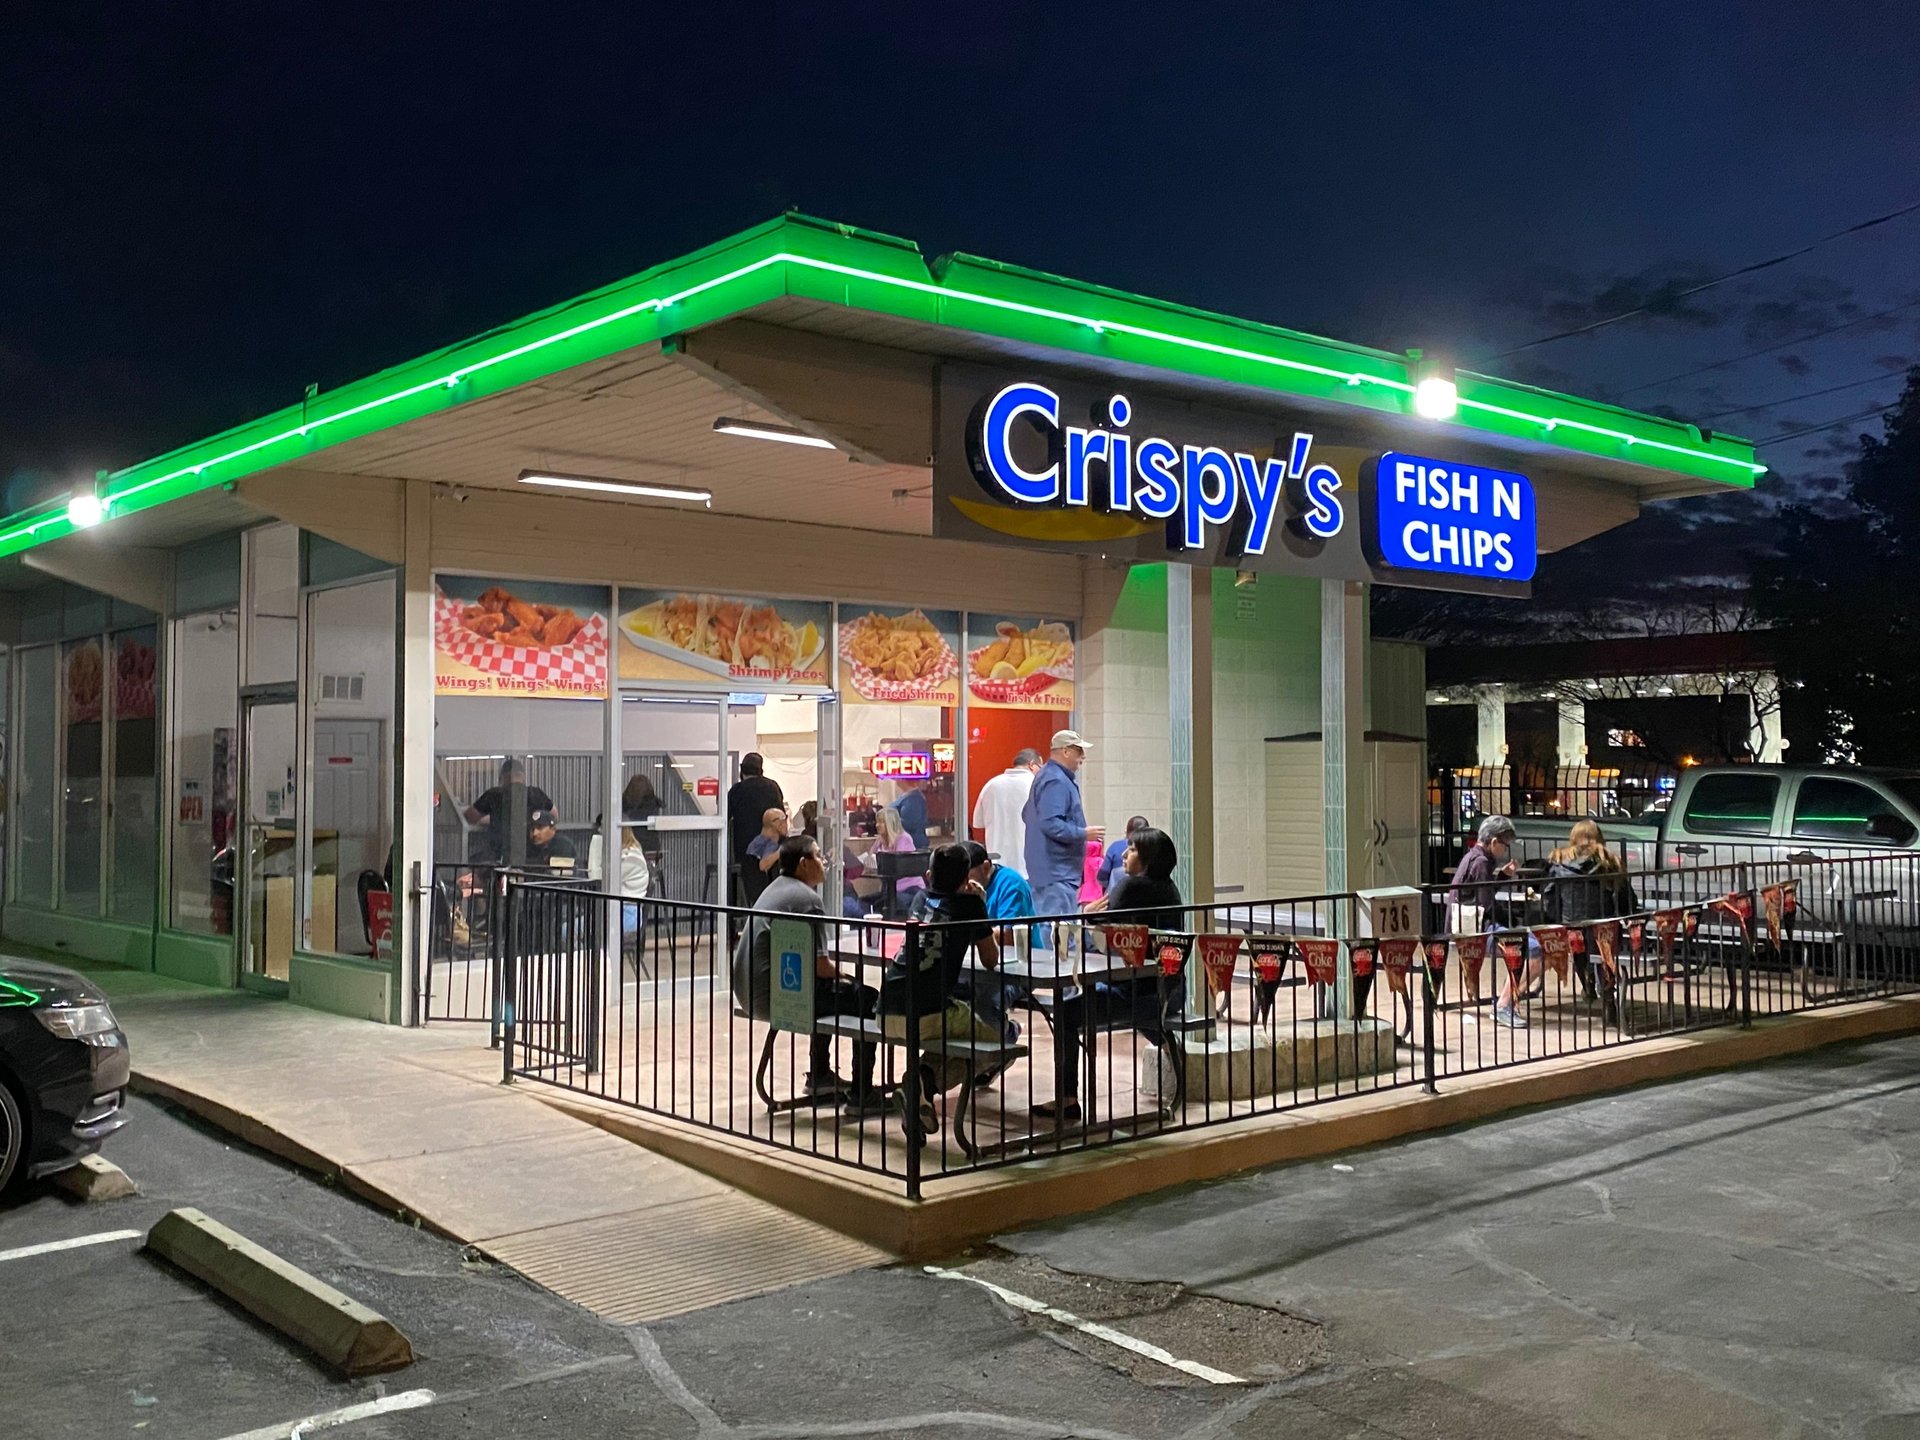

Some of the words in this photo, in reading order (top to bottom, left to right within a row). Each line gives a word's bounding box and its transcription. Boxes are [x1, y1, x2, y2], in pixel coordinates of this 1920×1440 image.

[983, 382, 1344, 555] Crispy's
[1396, 462, 1478, 514] FISH
[1493, 479, 1520, 521] N
[1402, 520, 1514, 572] CHIPS
[728, 664, 780, 682] Shrimp
[784, 665, 825, 680] Tacos
[436, 675, 491, 691] Wings!
[496, 676, 550, 693] Wings!
[554, 678, 605, 694] Wings!
[872, 687, 907, 700] Fried
[910, 687, 955, 703] Shrimp
[1034, 695, 1042, 704] &
[1044, 694, 1072, 706] Fries
[871, 756, 927, 775] OPEN
[1379, 904, 1410, 933] 736
[1112, 931, 1143, 949] Coke
[1206, 949, 1233, 966] Coke
[1308, 951, 1333, 968] Coke
[1386, 951, 1409, 966] Coke
